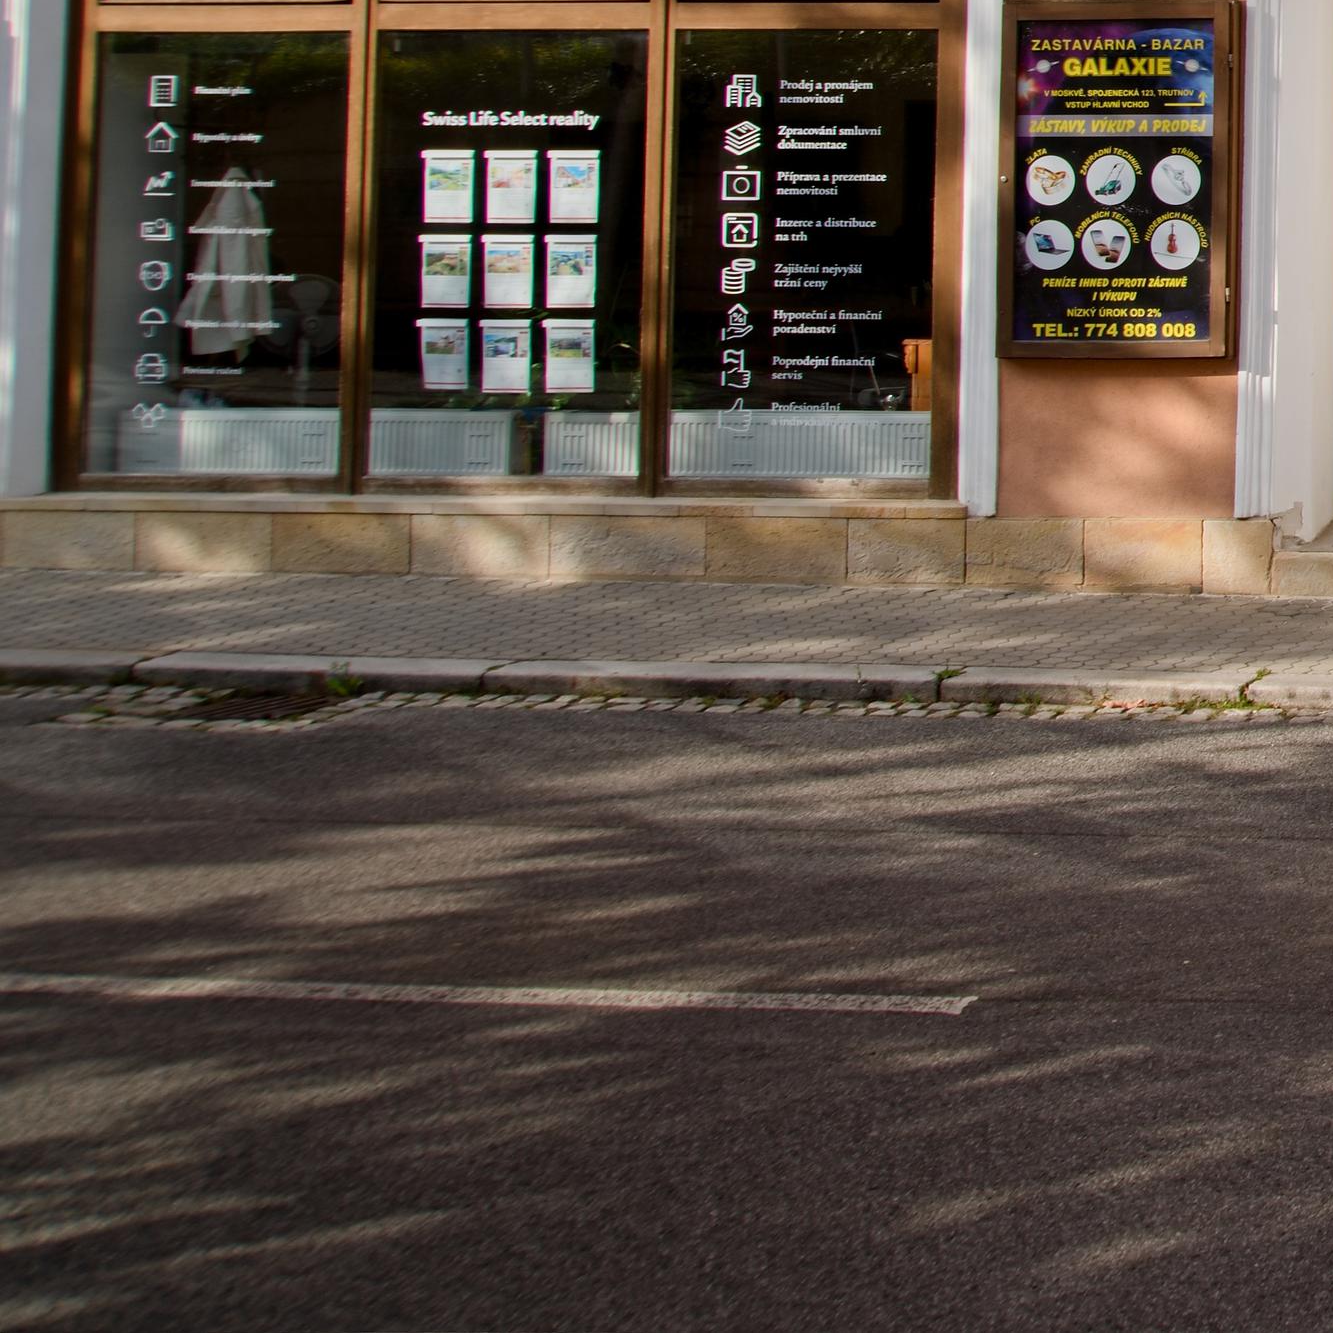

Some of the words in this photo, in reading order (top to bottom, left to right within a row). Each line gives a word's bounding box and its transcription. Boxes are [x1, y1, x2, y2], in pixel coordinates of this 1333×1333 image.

[1031, 37, 1136, 51] ZASTAVÁRNA
[1151, 39, 1205, 51] BAZAR
[1063, 57, 1173, 77] GALAXIE
[780, 80, 813, 92] Prodej
[824, 80, 873, 93] pronájem
[1087, 88, 1140, 97] SPOJENECKÁ
[1157, 89, 1194, 97] TRUTNOV
[779, 94, 844, 104] nemovitostí
[1092, 100, 1121, 108] HLAVNÍ
[422, 110, 467, 126] Swiss
[469, 110, 500, 126] Life
[500, 110, 548, 126] Select
[550, 110, 600, 130] reality
[1029, 117, 1086, 134] ZÁSTAVY,
[1091, 117, 1135, 133] VÝKUP
[1138, 120, 1148, 132] A
[1152, 119, 1207, 133] PRODEJ
[778, 125, 837, 138] Zpracování
[839, 125, 882, 136] smluvní
[777, 140, 847, 150] dokumentace
[1025, 147, 1048, 165] ZLATA
[1080, 146, 1112, 176] ZAHRADNÍ
[1113, 147, 1143, 176] TECHNIKY
[1171, 147, 1203, 166] STŘÍBRA
[776, 171, 821, 184] Příprava
[831, 173, 888, 184] prezentace
[775, 217, 814, 228] Inzerce
[824, 217, 877, 228] distribuce
[1029, 216, 1041, 227] PC
[1074, 210, 1110, 239] MOBILNÍCH
[1144, 211, 1180, 242] HUDEBNÍCH
[1181, 212, 1209, 248] NÁSTROJŮ
[775, 233, 789, 242] na
[791, 231, 808, 242] trh
[774, 263, 820, 274] Zajištění
[821, 263, 863, 275] nejvyšší
[774, 278, 801, 288] tržní
[803, 280, 828, 290] ceny
[1042, 276, 1077, 288] PENÍZE
[1078, 278, 1108, 288] IHNED
[1111, 278, 1147, 288] OPROTI
[1148, 276, 1188, 288] ZÁSTAVĚ
[1092, 291, 1098, 301] I
[1100, 290, 1137, 301] VÝKUPU
[773, 310, 827, 323] Hypoteční
[838, 310, 882, 320] finanční
[1067, 306, 1097, 317] NÍZKÝ
[1099, 307, 1128, 317] ÚROK
[1129, 309, 1146, 317] OD
[1147, 309, 1162, 317] 2%
[772, 324, 836, 336] poradenství
[1032, 323, 1079, 337] TEL.:
[1084, 323, 1118, 337] 774
[1123, 323, 1157, 337] 808
[1162, 323, 1196, 337] 008
[771, 356, 829, 369] Poprodejní
[831, 356, 875, 366] finanční
[771, 370, 803, 380] servis
[771, 402, 841, 411] Profesionální
